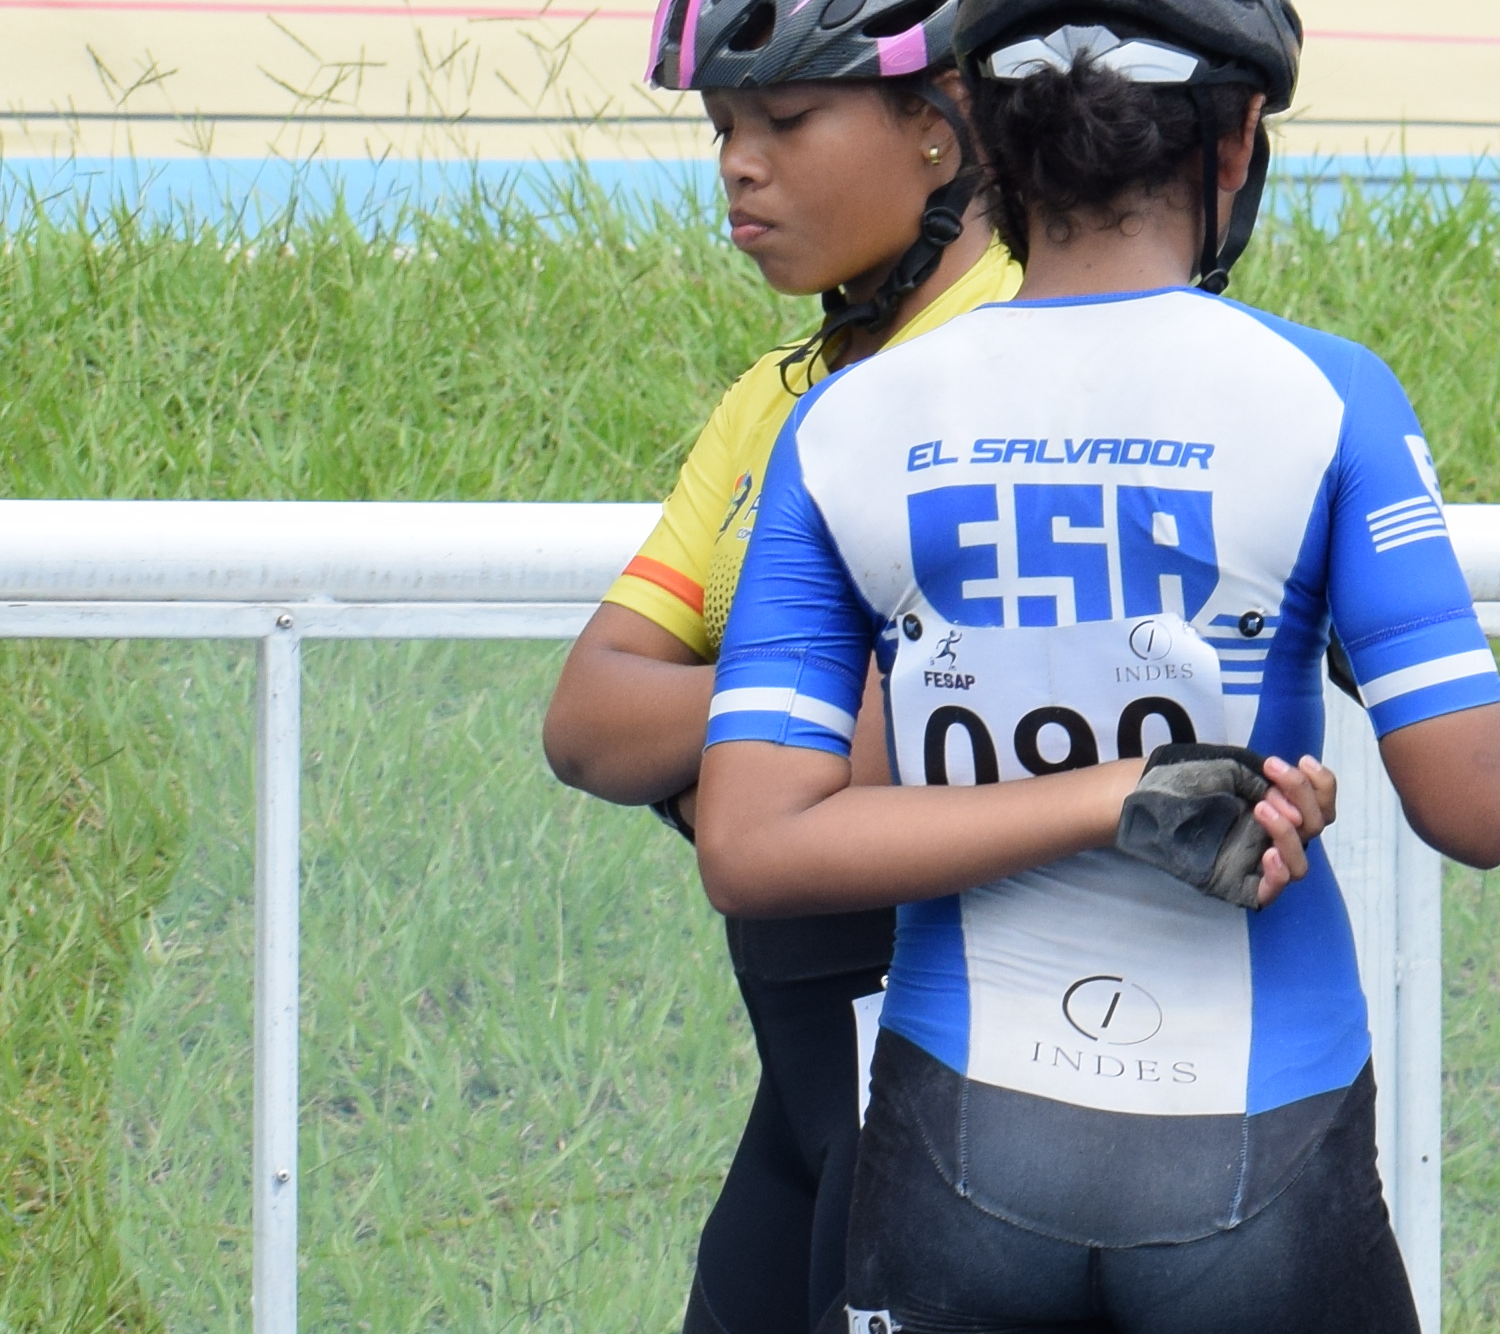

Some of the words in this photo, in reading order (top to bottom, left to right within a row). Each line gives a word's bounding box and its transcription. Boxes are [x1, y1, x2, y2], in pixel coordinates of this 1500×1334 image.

[906, 439, 959, 472] EL
[969, 437, 1216, 471] SALVADOR
[906, 483, 1221, 629] ESA
[924, 670, 976, 691] FESAP
[1115, 662, 1194, 684] INDES
[1031, 1041, 1199, 1085] INDES
